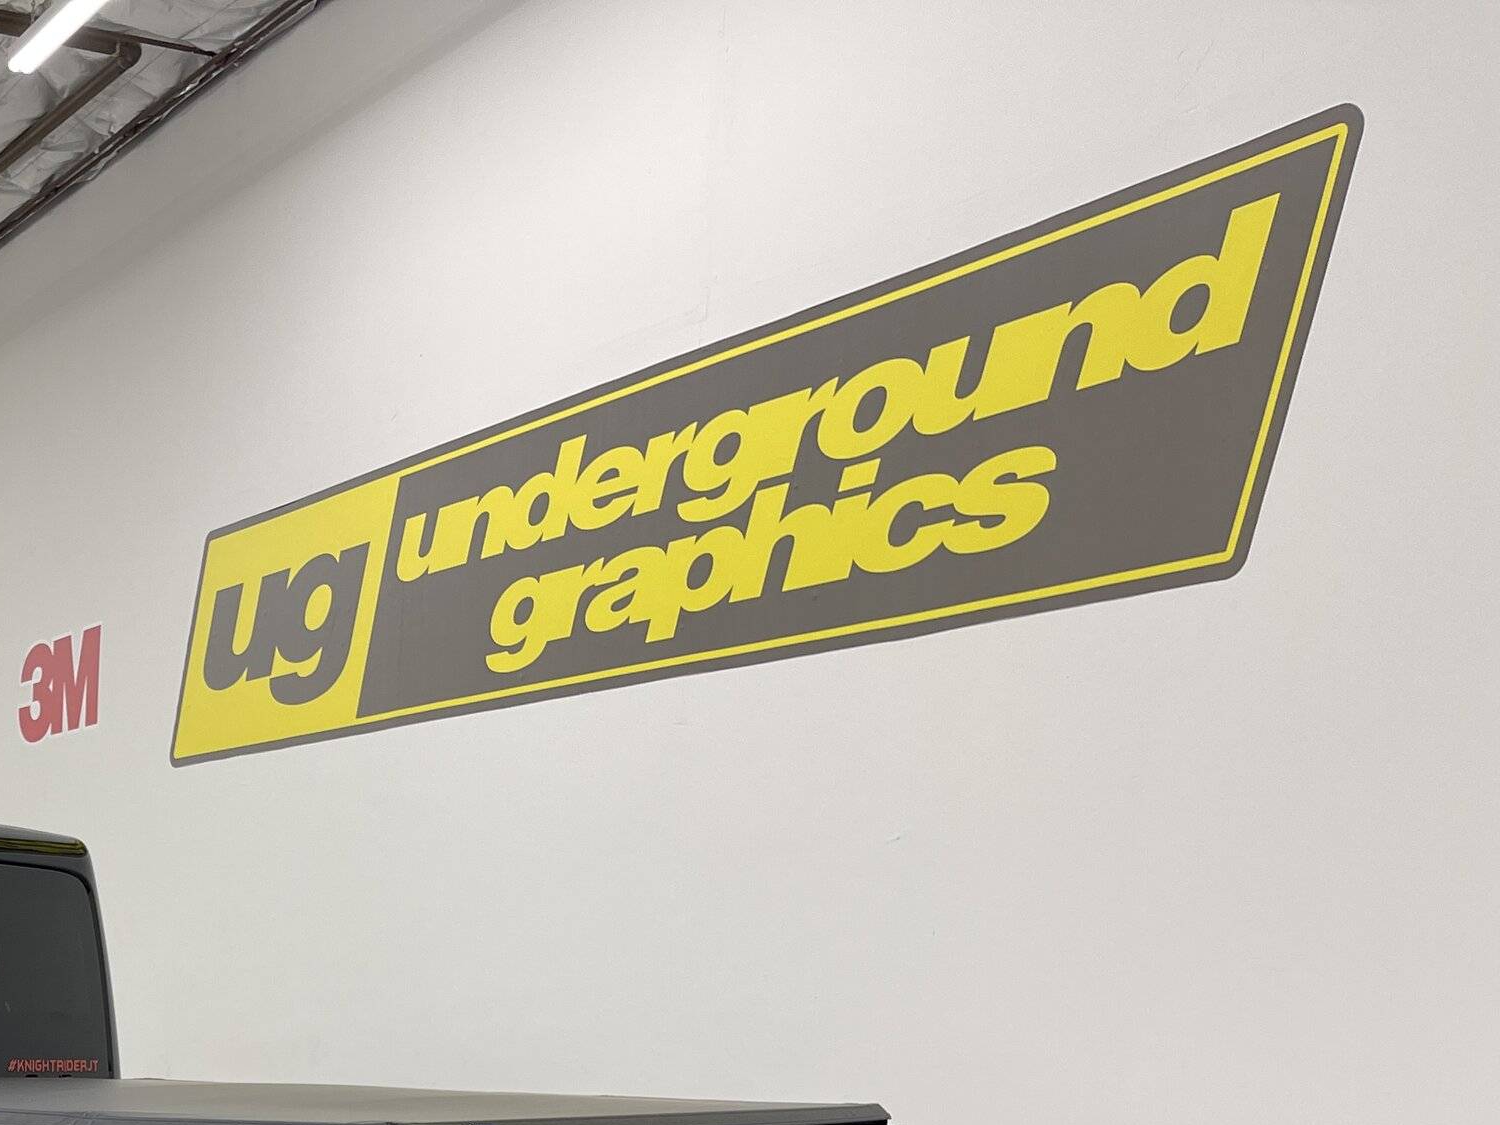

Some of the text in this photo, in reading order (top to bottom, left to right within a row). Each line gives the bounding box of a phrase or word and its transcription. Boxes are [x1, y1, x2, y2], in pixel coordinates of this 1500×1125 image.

[396, 193, 1280, 581] underground
[202, 541, 370, 705] ug
[486, 446, 1057, 673] graphics
[18, 625, 102, 742] 3M
[8, 1058, 99, 1073] #KNIGHTRIDERJT
